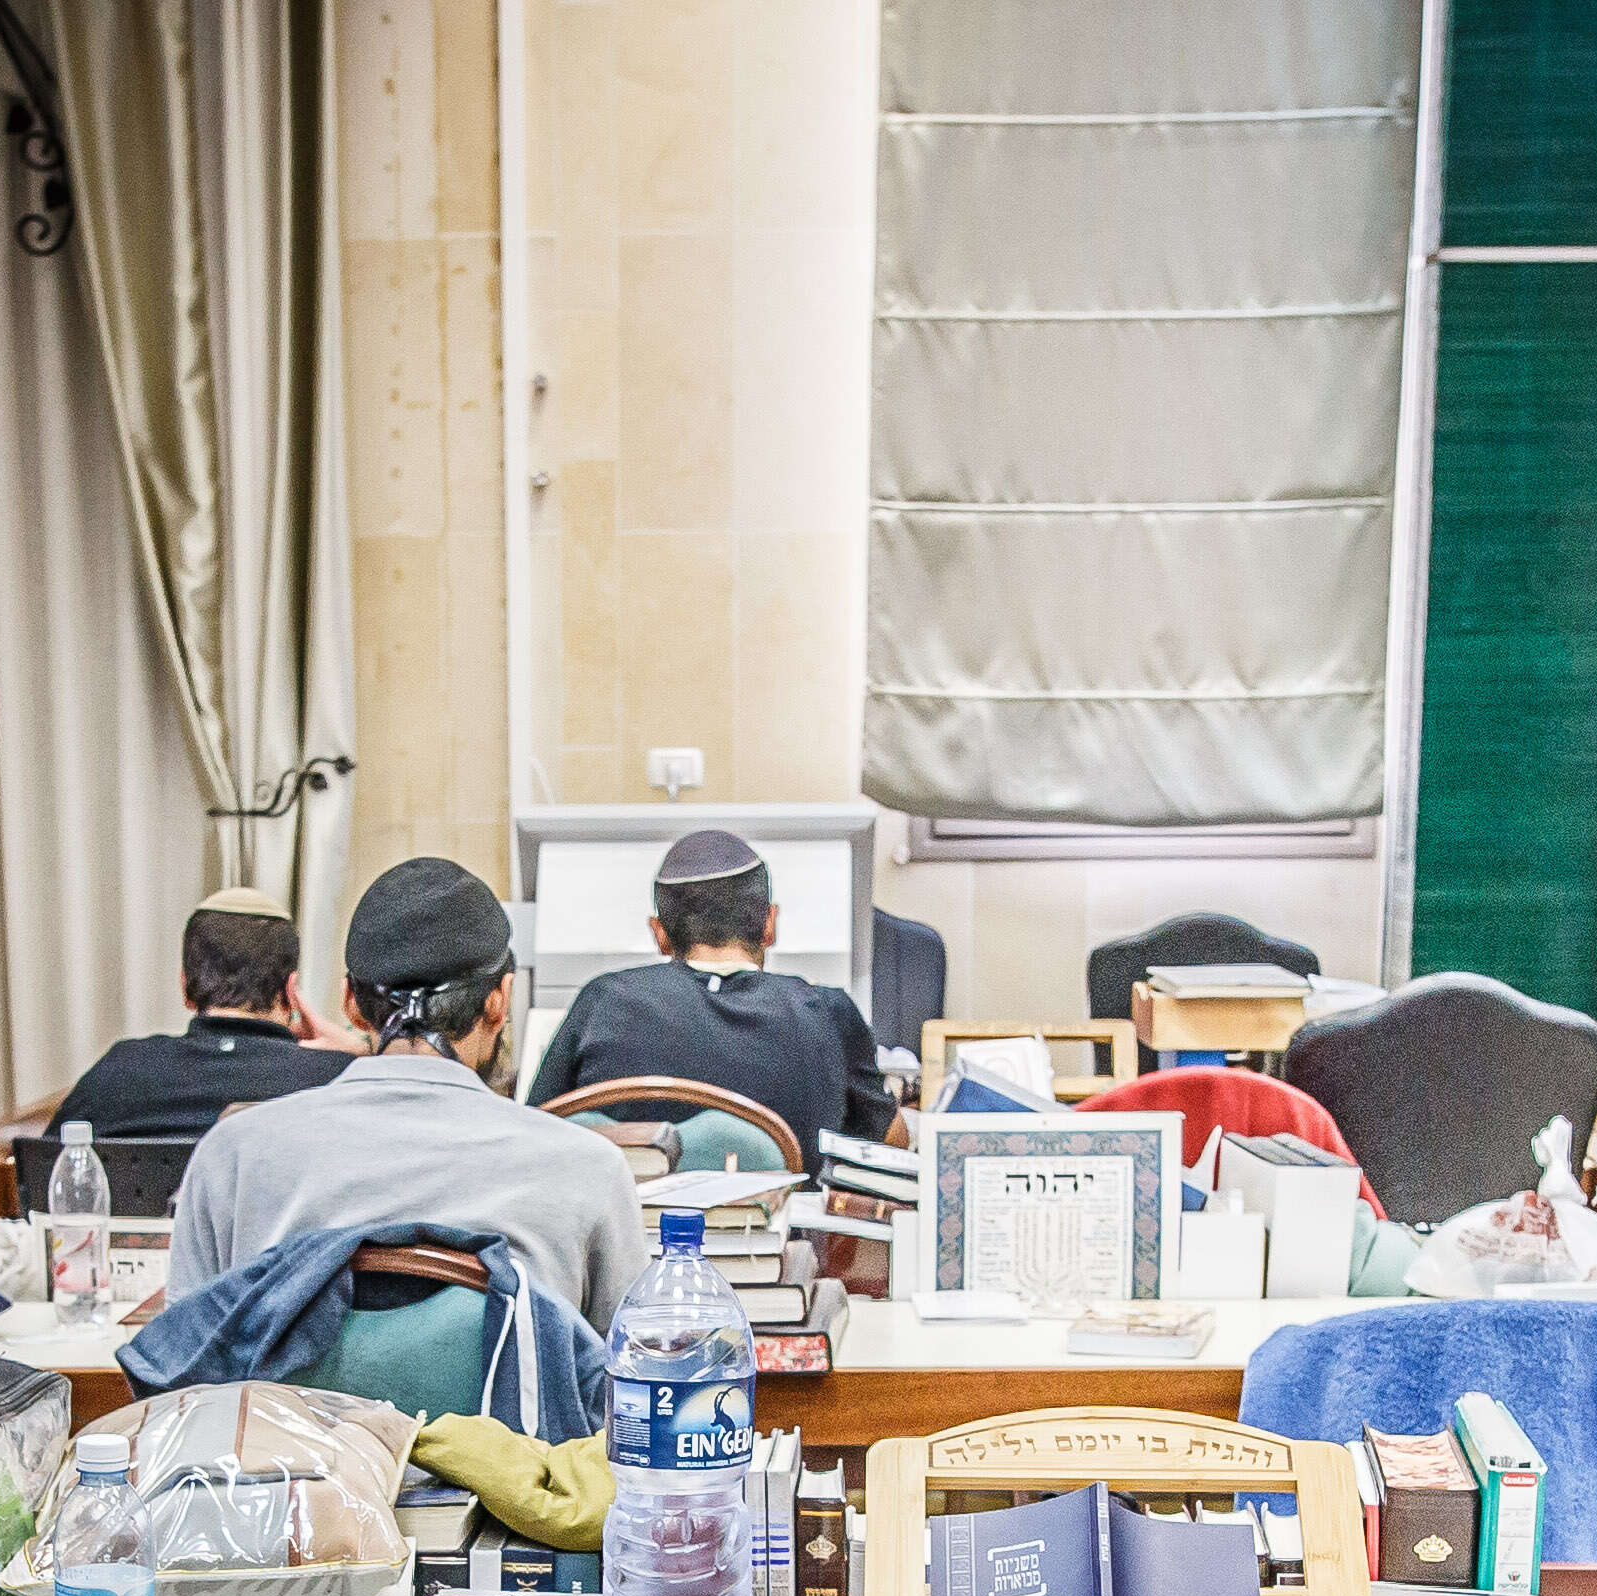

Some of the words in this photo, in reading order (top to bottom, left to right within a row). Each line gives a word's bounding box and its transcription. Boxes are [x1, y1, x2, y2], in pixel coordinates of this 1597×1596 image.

[1005, 1174, 1094, 1194] יהוה
[656, 1386, 674, 1408] 2
[676, 1432, 716, 1458] EIN
[721, 1426, 753, 1455] GEDI
[943, 1431, 1037, 1466] ולילה
[1054, 1433, 1121, 1453] יומם
[1137, 1433, 1169, 1453] בו
[1186, 1437, 1275, 1467] והגית
[995, 1554, 1040, 1575] משניות
